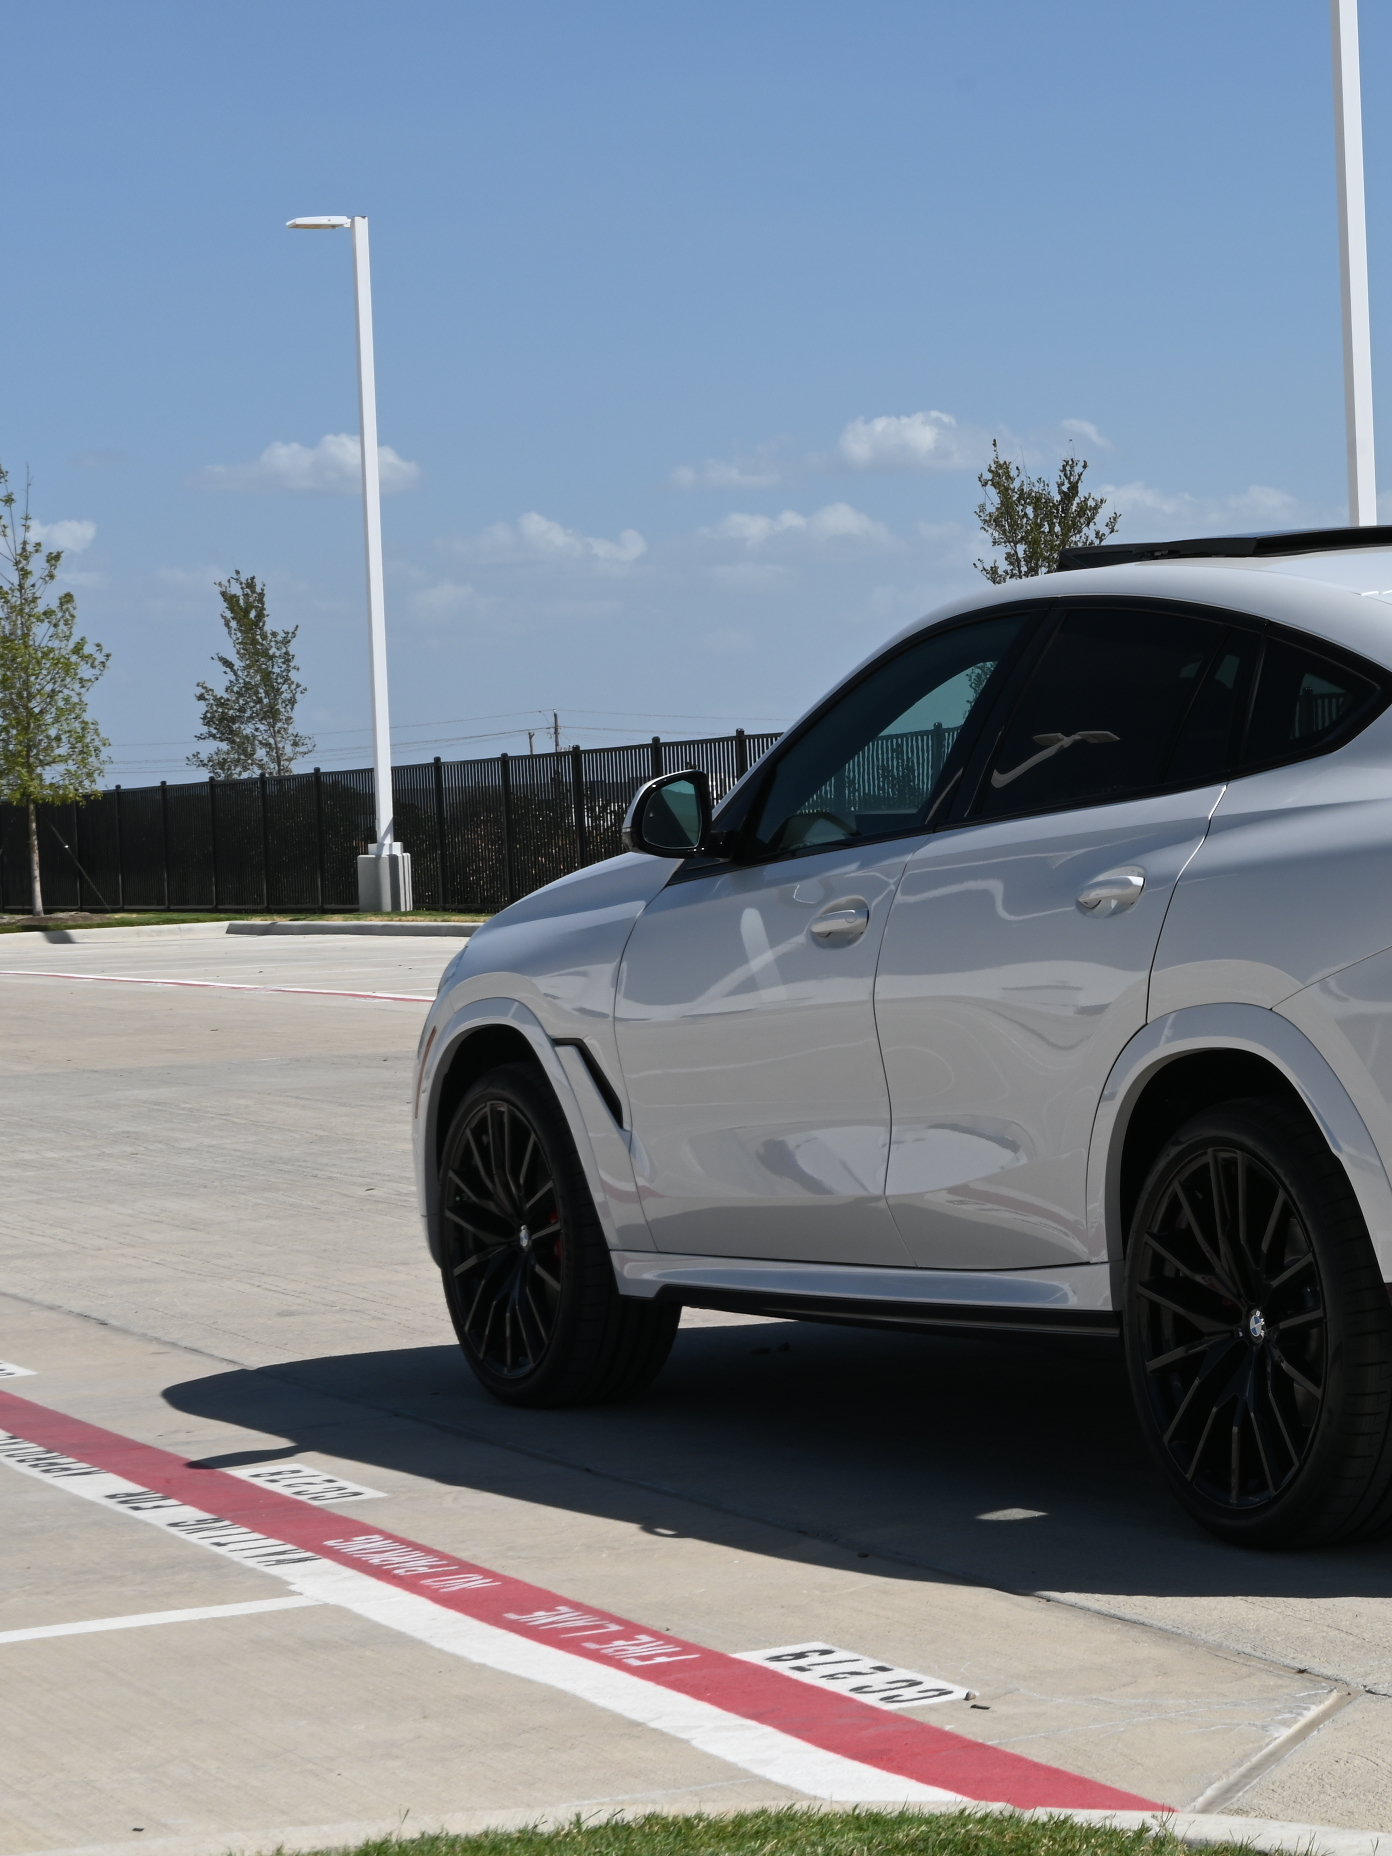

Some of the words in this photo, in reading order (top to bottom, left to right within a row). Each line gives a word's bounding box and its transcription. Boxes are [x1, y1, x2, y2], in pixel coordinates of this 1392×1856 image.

[104, 1490, 186, 1512] FOR
[248, 1469, 364, 1501] CC278
[166, 1517, 322, 1567] WAITING
[322, 1534, 459, 1576] PARKING
[419, 1573, 503, 1593] NO
[502, 1605, 625, 1638] LANE
[580, 1634, 701, 1666] FIRE
[764, 1649, 955, 1704] CC279
